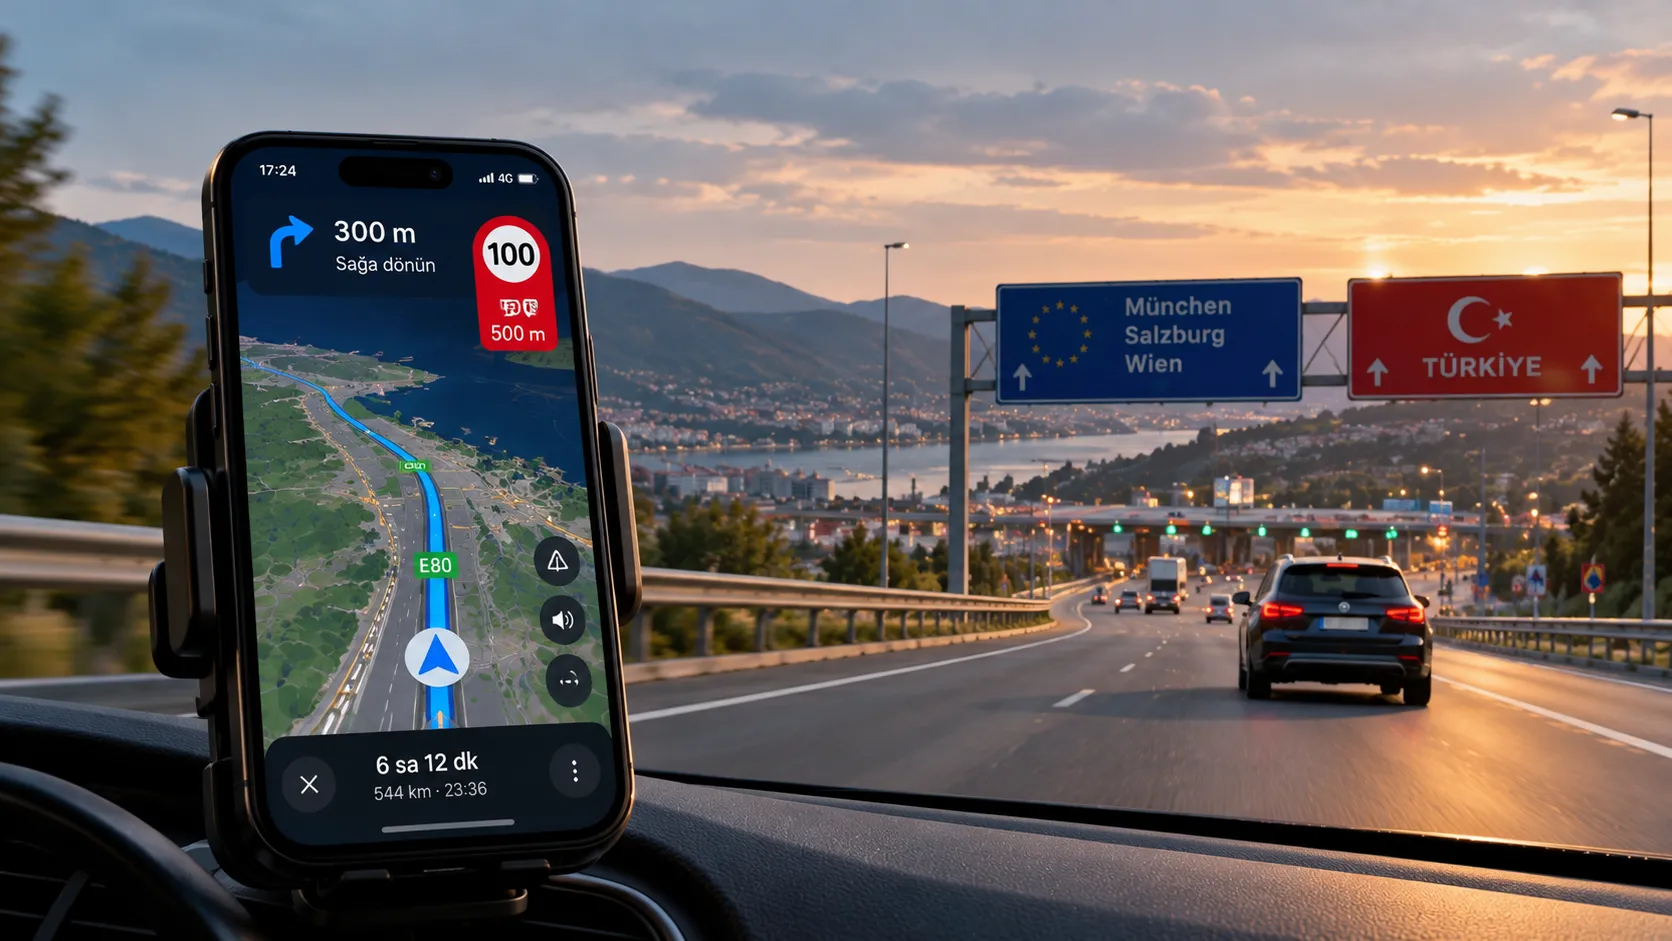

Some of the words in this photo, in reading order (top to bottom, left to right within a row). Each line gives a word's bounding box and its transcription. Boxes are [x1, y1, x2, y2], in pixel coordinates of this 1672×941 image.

[259, 164, 297, 177] 17:24
[497, 173, 514, 184] 4G
[334, 220, 386, 243] 300
[392, 227, 416, 244] m
[487, 241, 536, 267] 100
[336, 255, 378, 275] Sağa
[383, 256, 436, 273] dönün
[1125, 295, 1232, 317] München
[491, 324, 524, 342] 500
[529, 329, 546, 342] m
[1124, 324, 1225, 348] Salzburg
[1125, 353, 1183, 373] Wien
[1422, 351, 1542, 378] TÜRKİYE
[419, 557, 452, 573] E80
[376, 755, 390, 775] 6
[395, 758, 419, 774] sa
[424, 752, 448, 772] 12
[453, 750, 479, 771] dk
[374, 785, 404, 801] 544
[408, 784, 432, 799] km
[444, 781, 488, 797] 23:36
